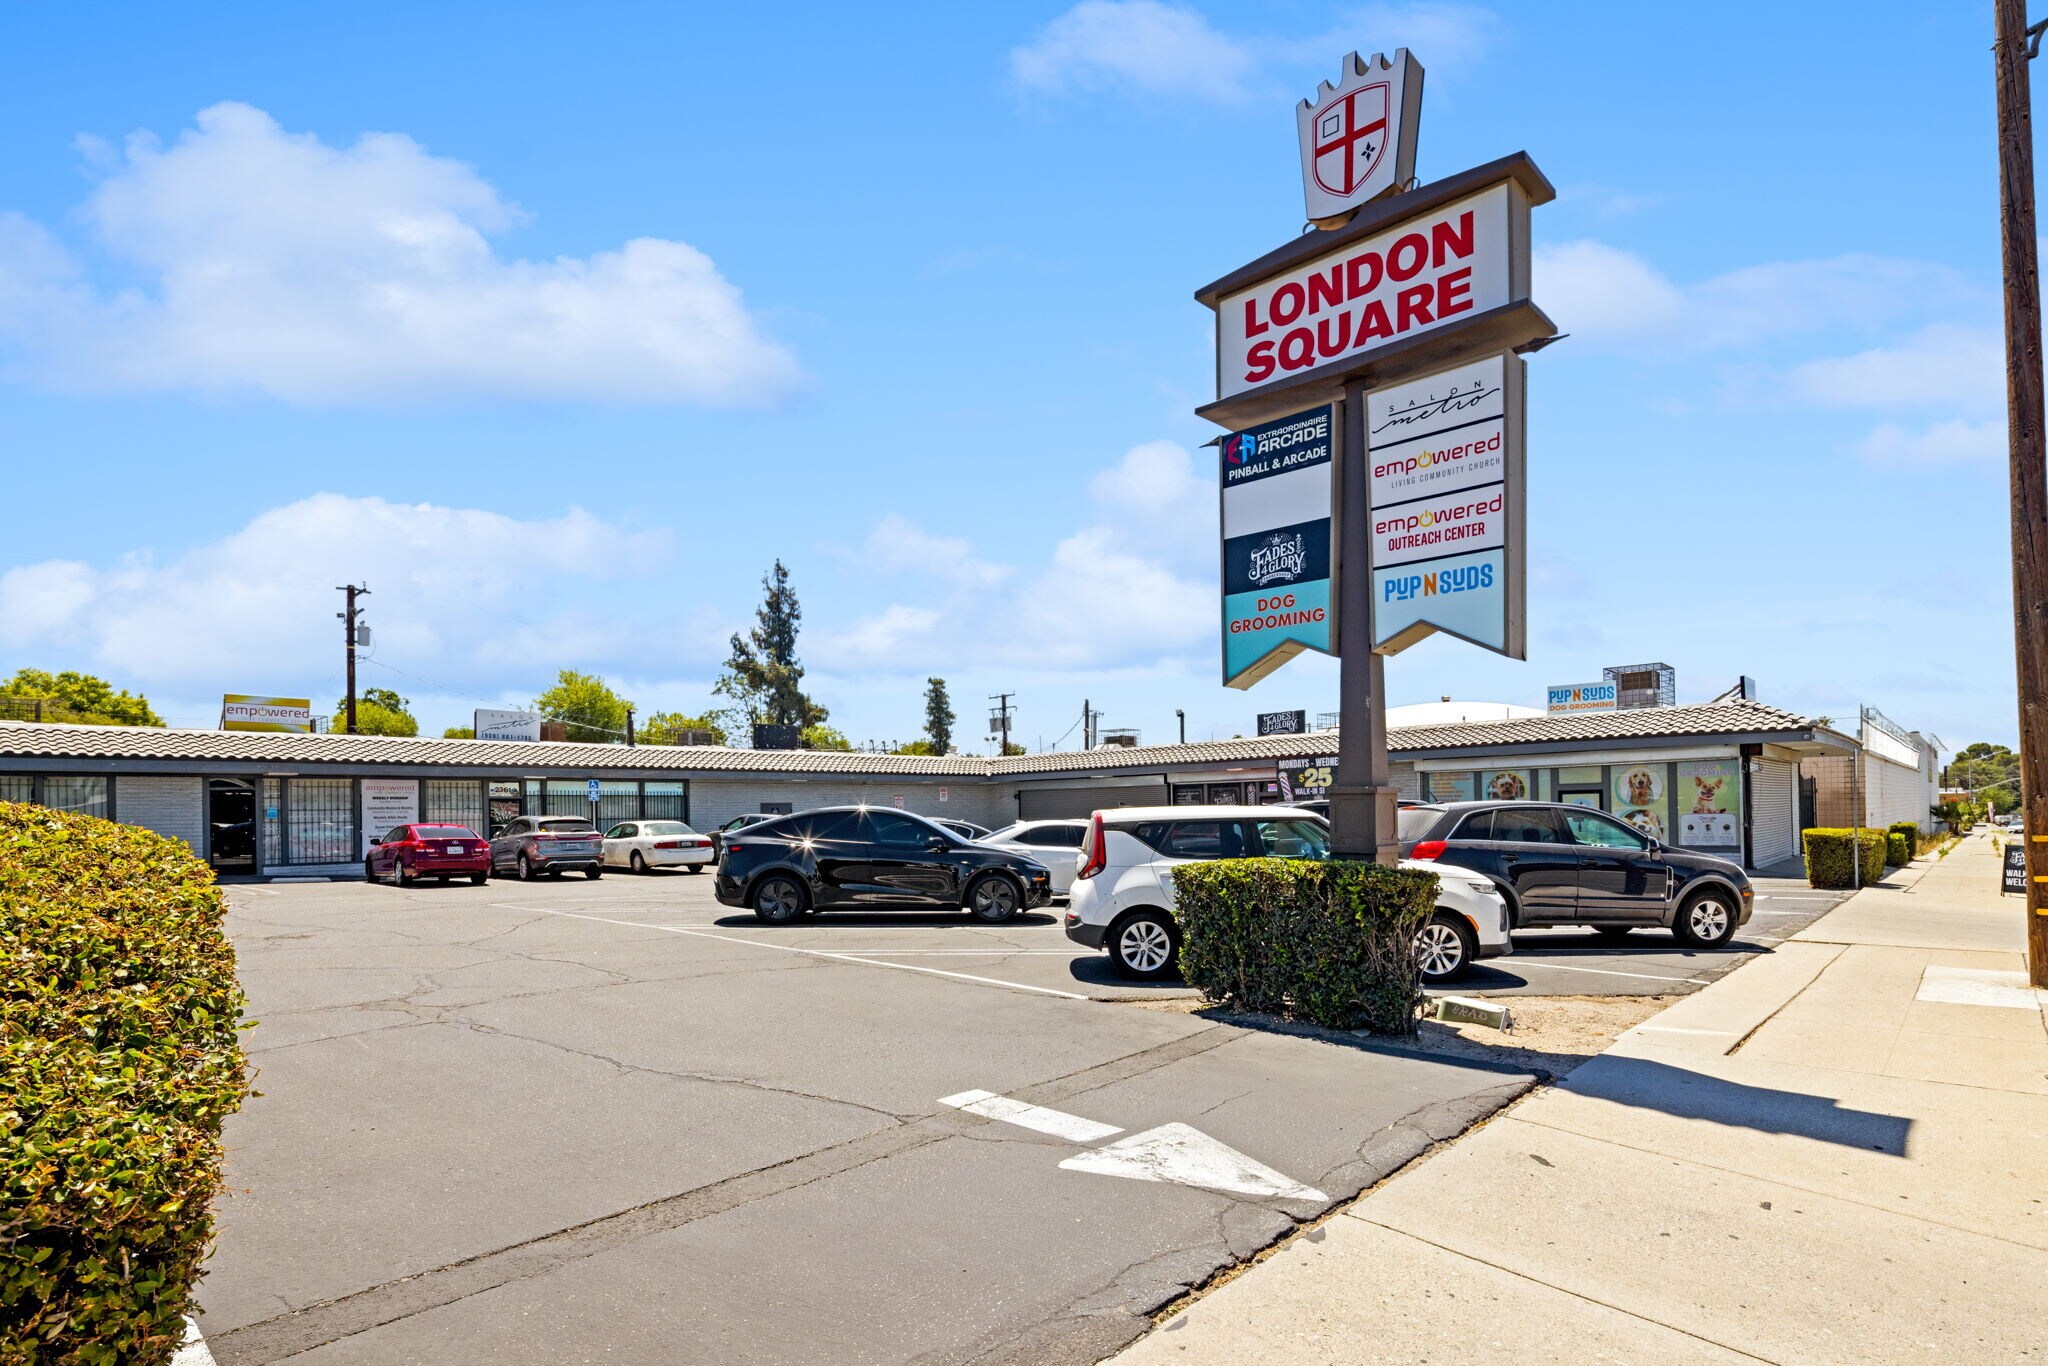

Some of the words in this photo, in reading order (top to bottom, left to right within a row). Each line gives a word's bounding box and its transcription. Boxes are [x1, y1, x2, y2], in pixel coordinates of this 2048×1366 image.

[1245, 210, 1474, 339] LONDON
[1244, 266, 1474, 383] SQUARE
[1372, 387, 1500, 434] metro
[1389, 380, 1481, 412] SALON
[1257, 414, 1327, 441] EXTRAORDINAIRE
[1257, 423, 1327, 455] ARCADE
[1229, 461, 1270, 480] PINBALL
[1272, 458, 1281, 469] &
[1282, 445, 1327, 467] ARCADE
[1374, 432, 1501, 478] empowered
[1391, 476, 1416, 489] LIVING
[1419, 465, 1464, 483] COMMUNITY
[1468, 457, 1501, 472] CHURCH
[1376, 494, 1502, 535] empowered
[1388, 528, 1442, 551] OUTREACH
[1444, 522, 1485, 542] CENTER
[1249, 541, 1295, 580] FADES
[1261, 565, 1268, 575] 4
[1268, 550, 1306, 574] GLORY
[1256, 593, 1295, 613] DOG
[1229, 607, 1326, 634] GROOMING
[1569, 701, 1614, 710] GROOMING
[1278, 758, 1310, 770] MONDAYS
[1315, 756, 1339, 767] WEDNE
[1298, 767, 1333, 788] $25
[1295, 787, 1318, 795] WALK-IN
